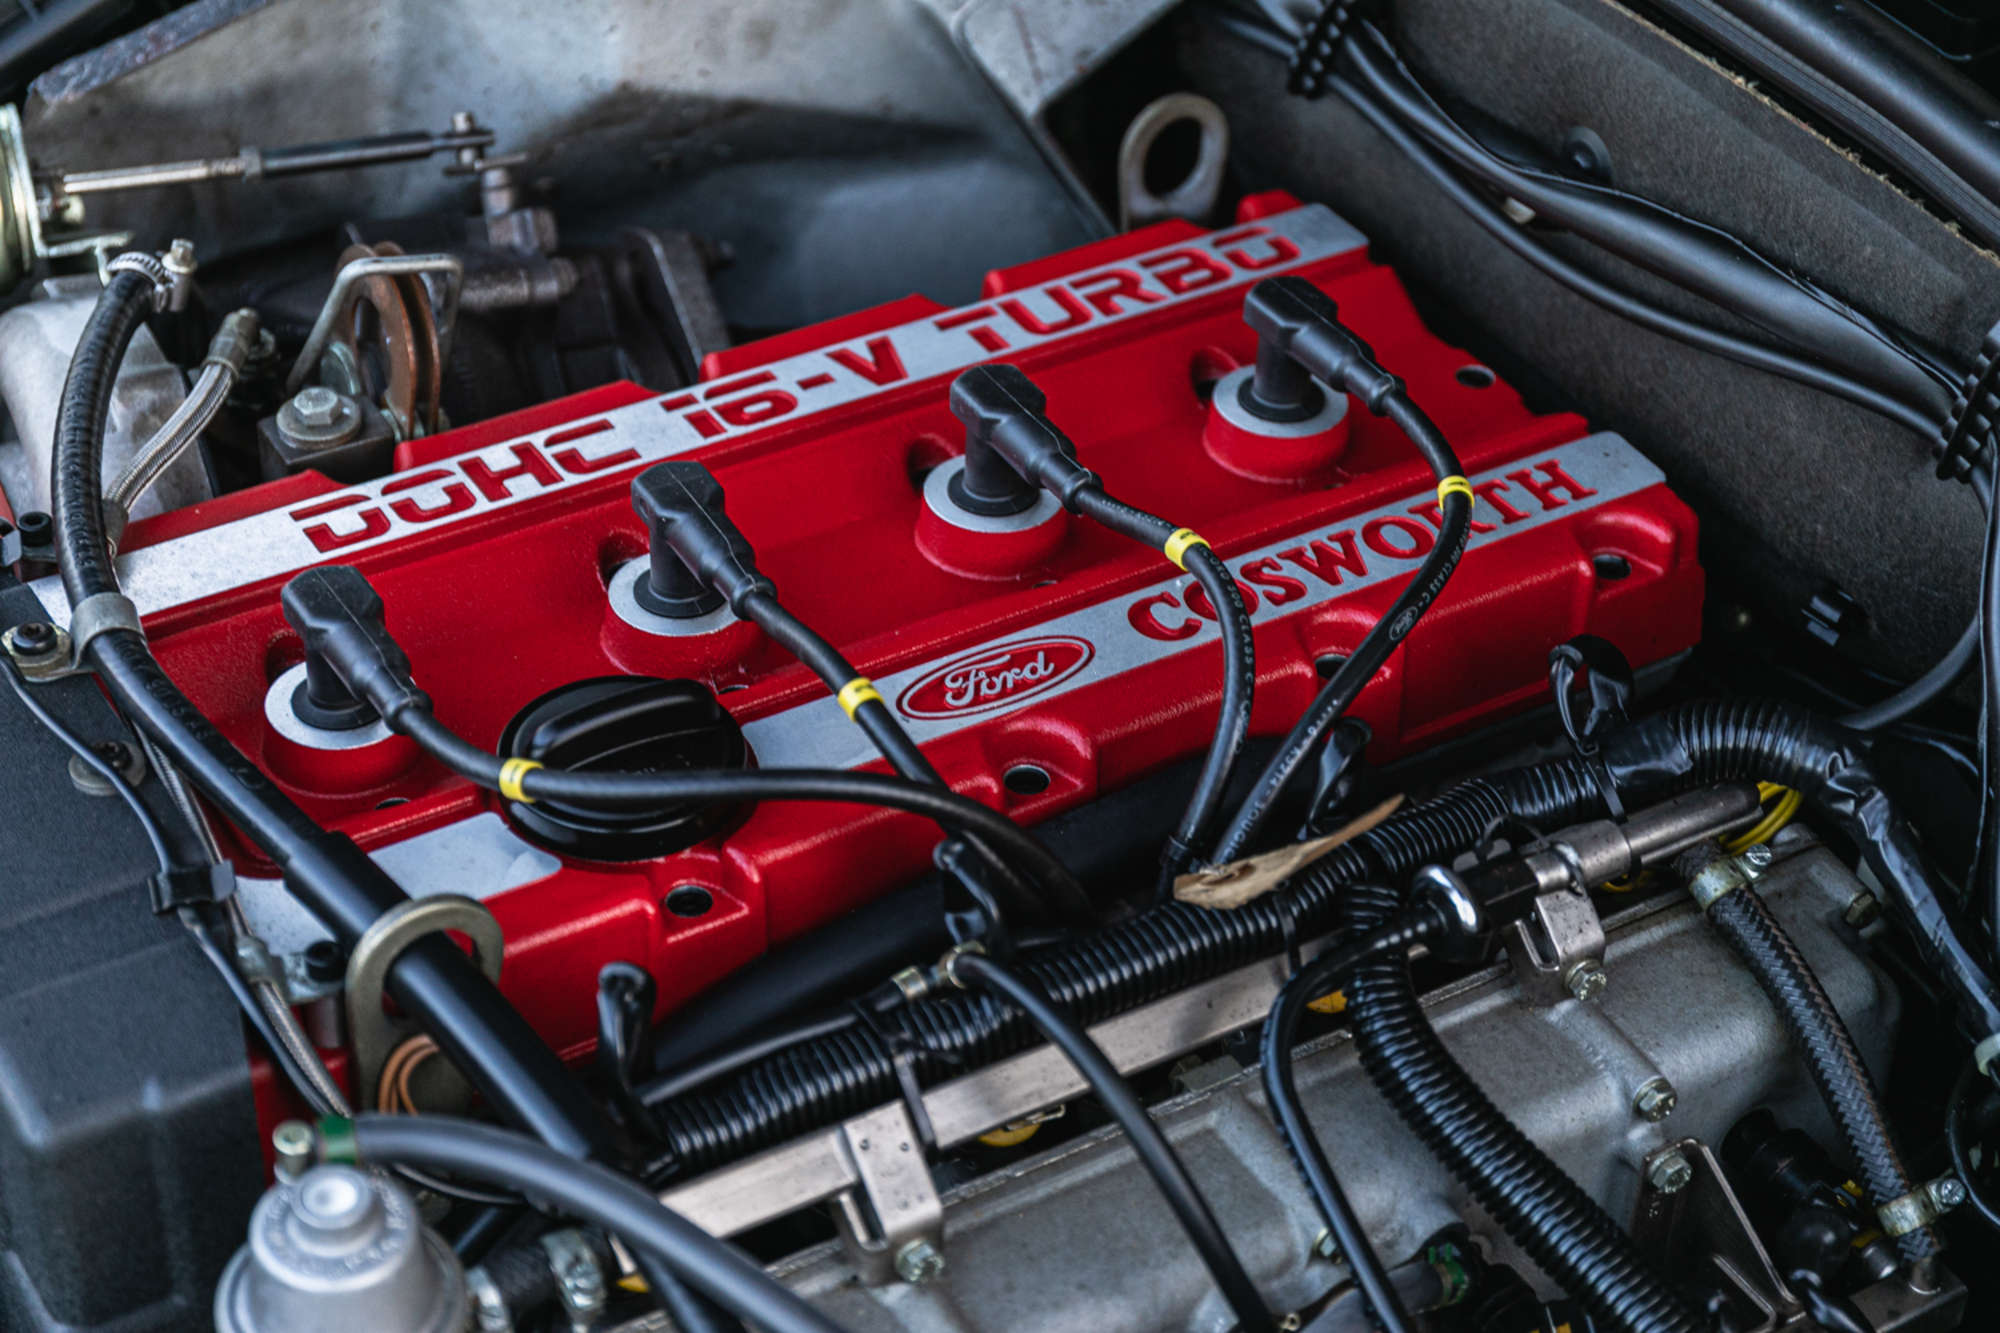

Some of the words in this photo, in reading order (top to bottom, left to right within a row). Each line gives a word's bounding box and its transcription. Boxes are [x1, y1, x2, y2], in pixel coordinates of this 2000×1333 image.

[289, 419, 641, 553] DOHC
[659, 336, 908, 439] 16-V
[933, 227, 1302, 353] TURBO
[944, 651, 1055, 706] Ford
